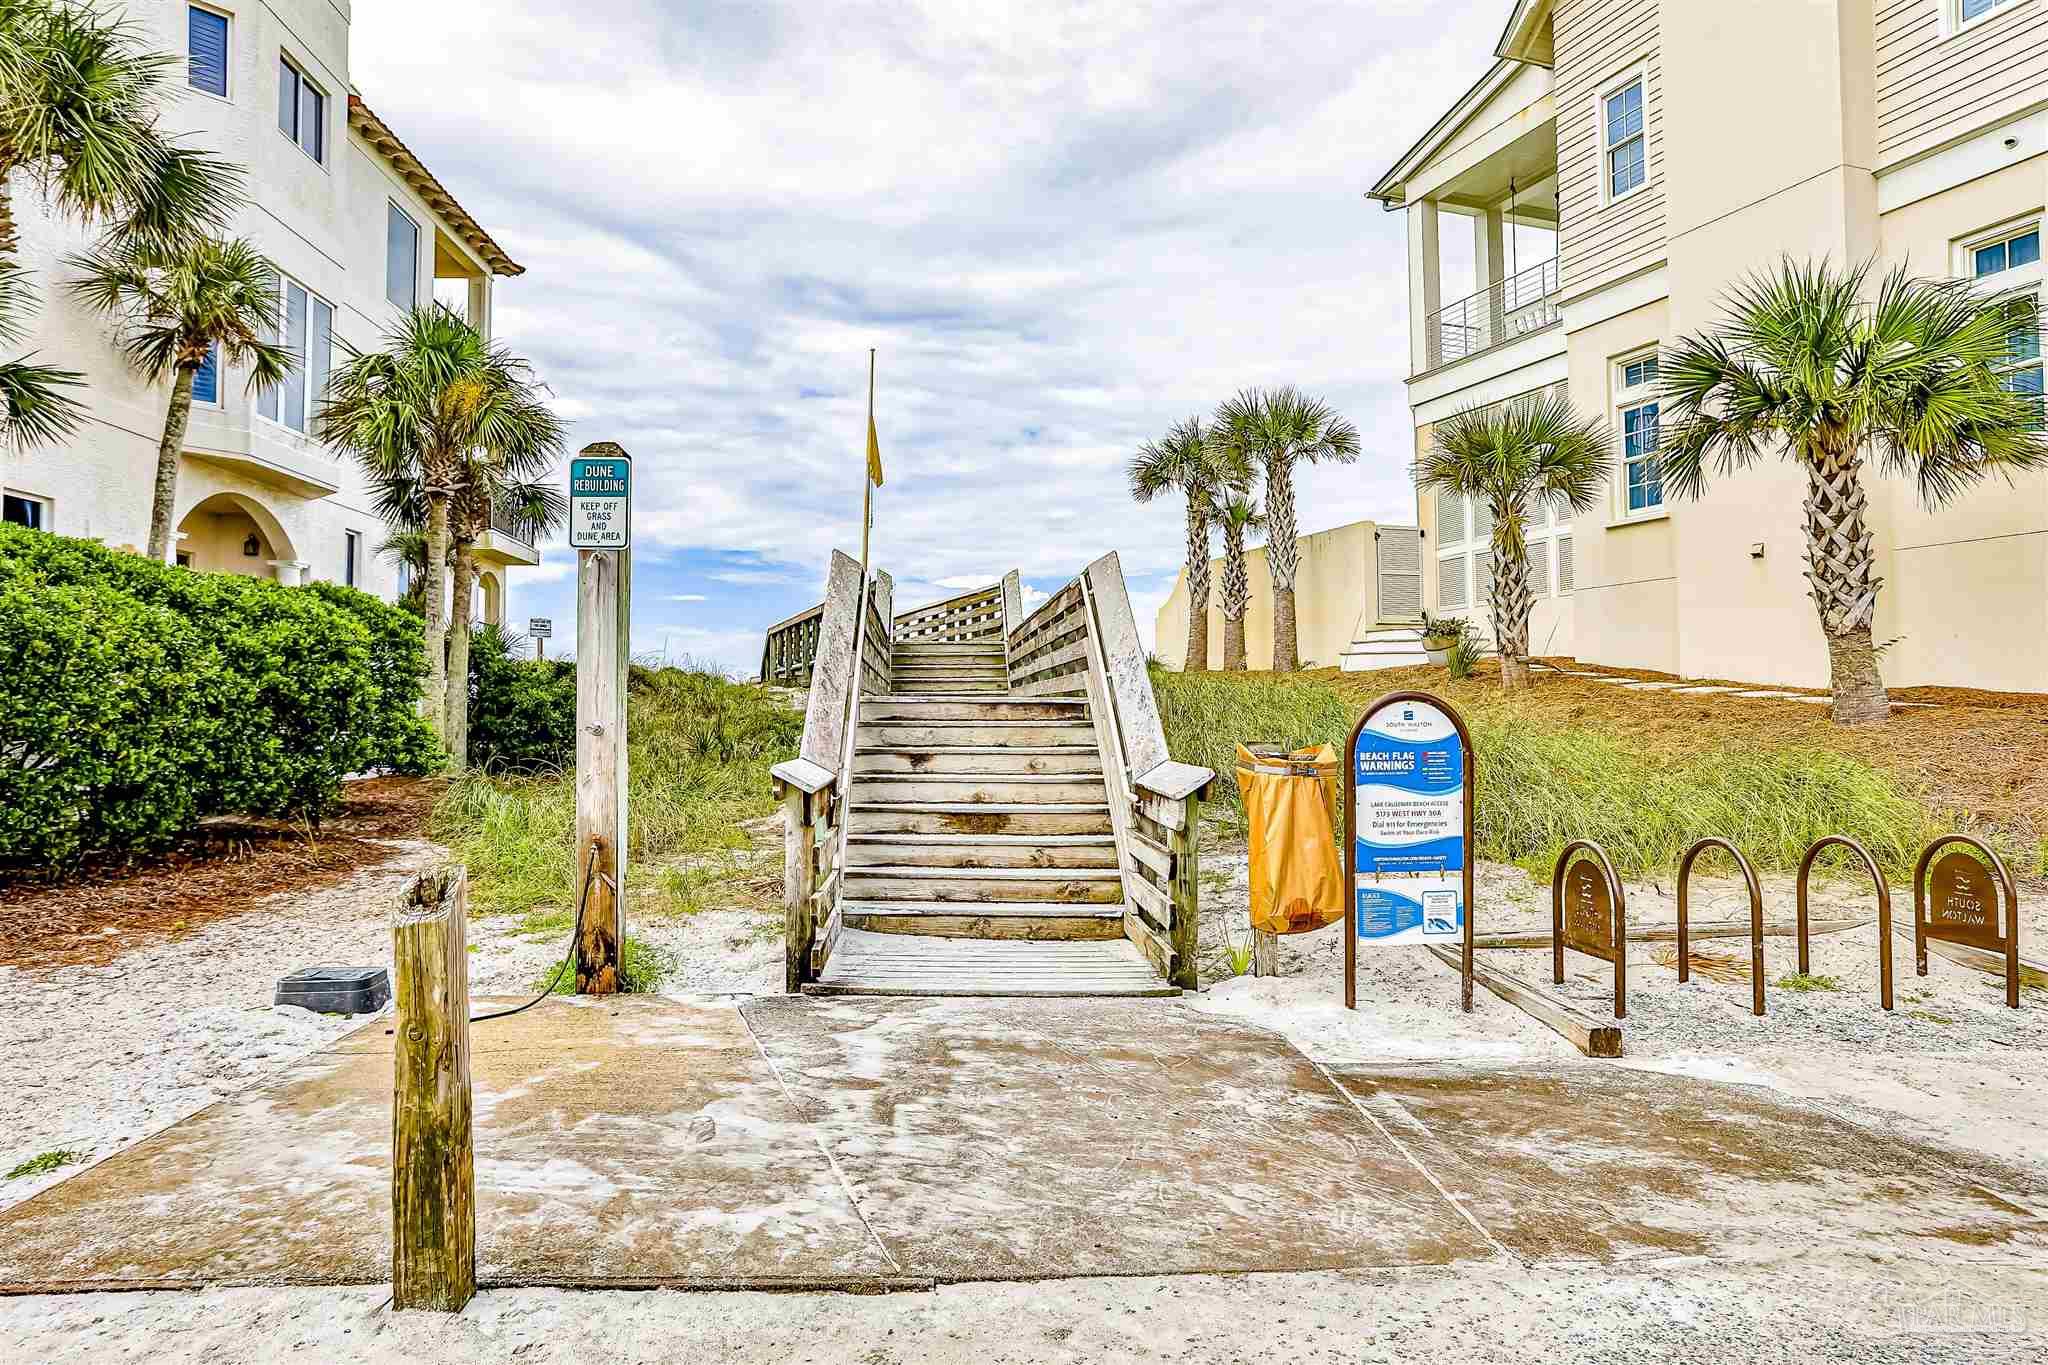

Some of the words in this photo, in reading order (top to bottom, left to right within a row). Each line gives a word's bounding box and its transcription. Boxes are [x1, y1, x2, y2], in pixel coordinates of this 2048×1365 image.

[585, 466, 614, 477] DUNE
[575, 480, 625, 492] REBUILDING
[580, 502, 600, 511] KEEP
[603, 502, 618, 511] OFF
[586, 512, 612, 520] GRASS
[591, 522, 607, 530] AND
[577, 532, 599, 541] DUNE
[601, 532, 621, 541] AREA
[1360, 752, 1389, 761] BEACH
[1392, 752, 1415, 760] FLAG
[1360, 761, 1415, 771] WARNINGS
